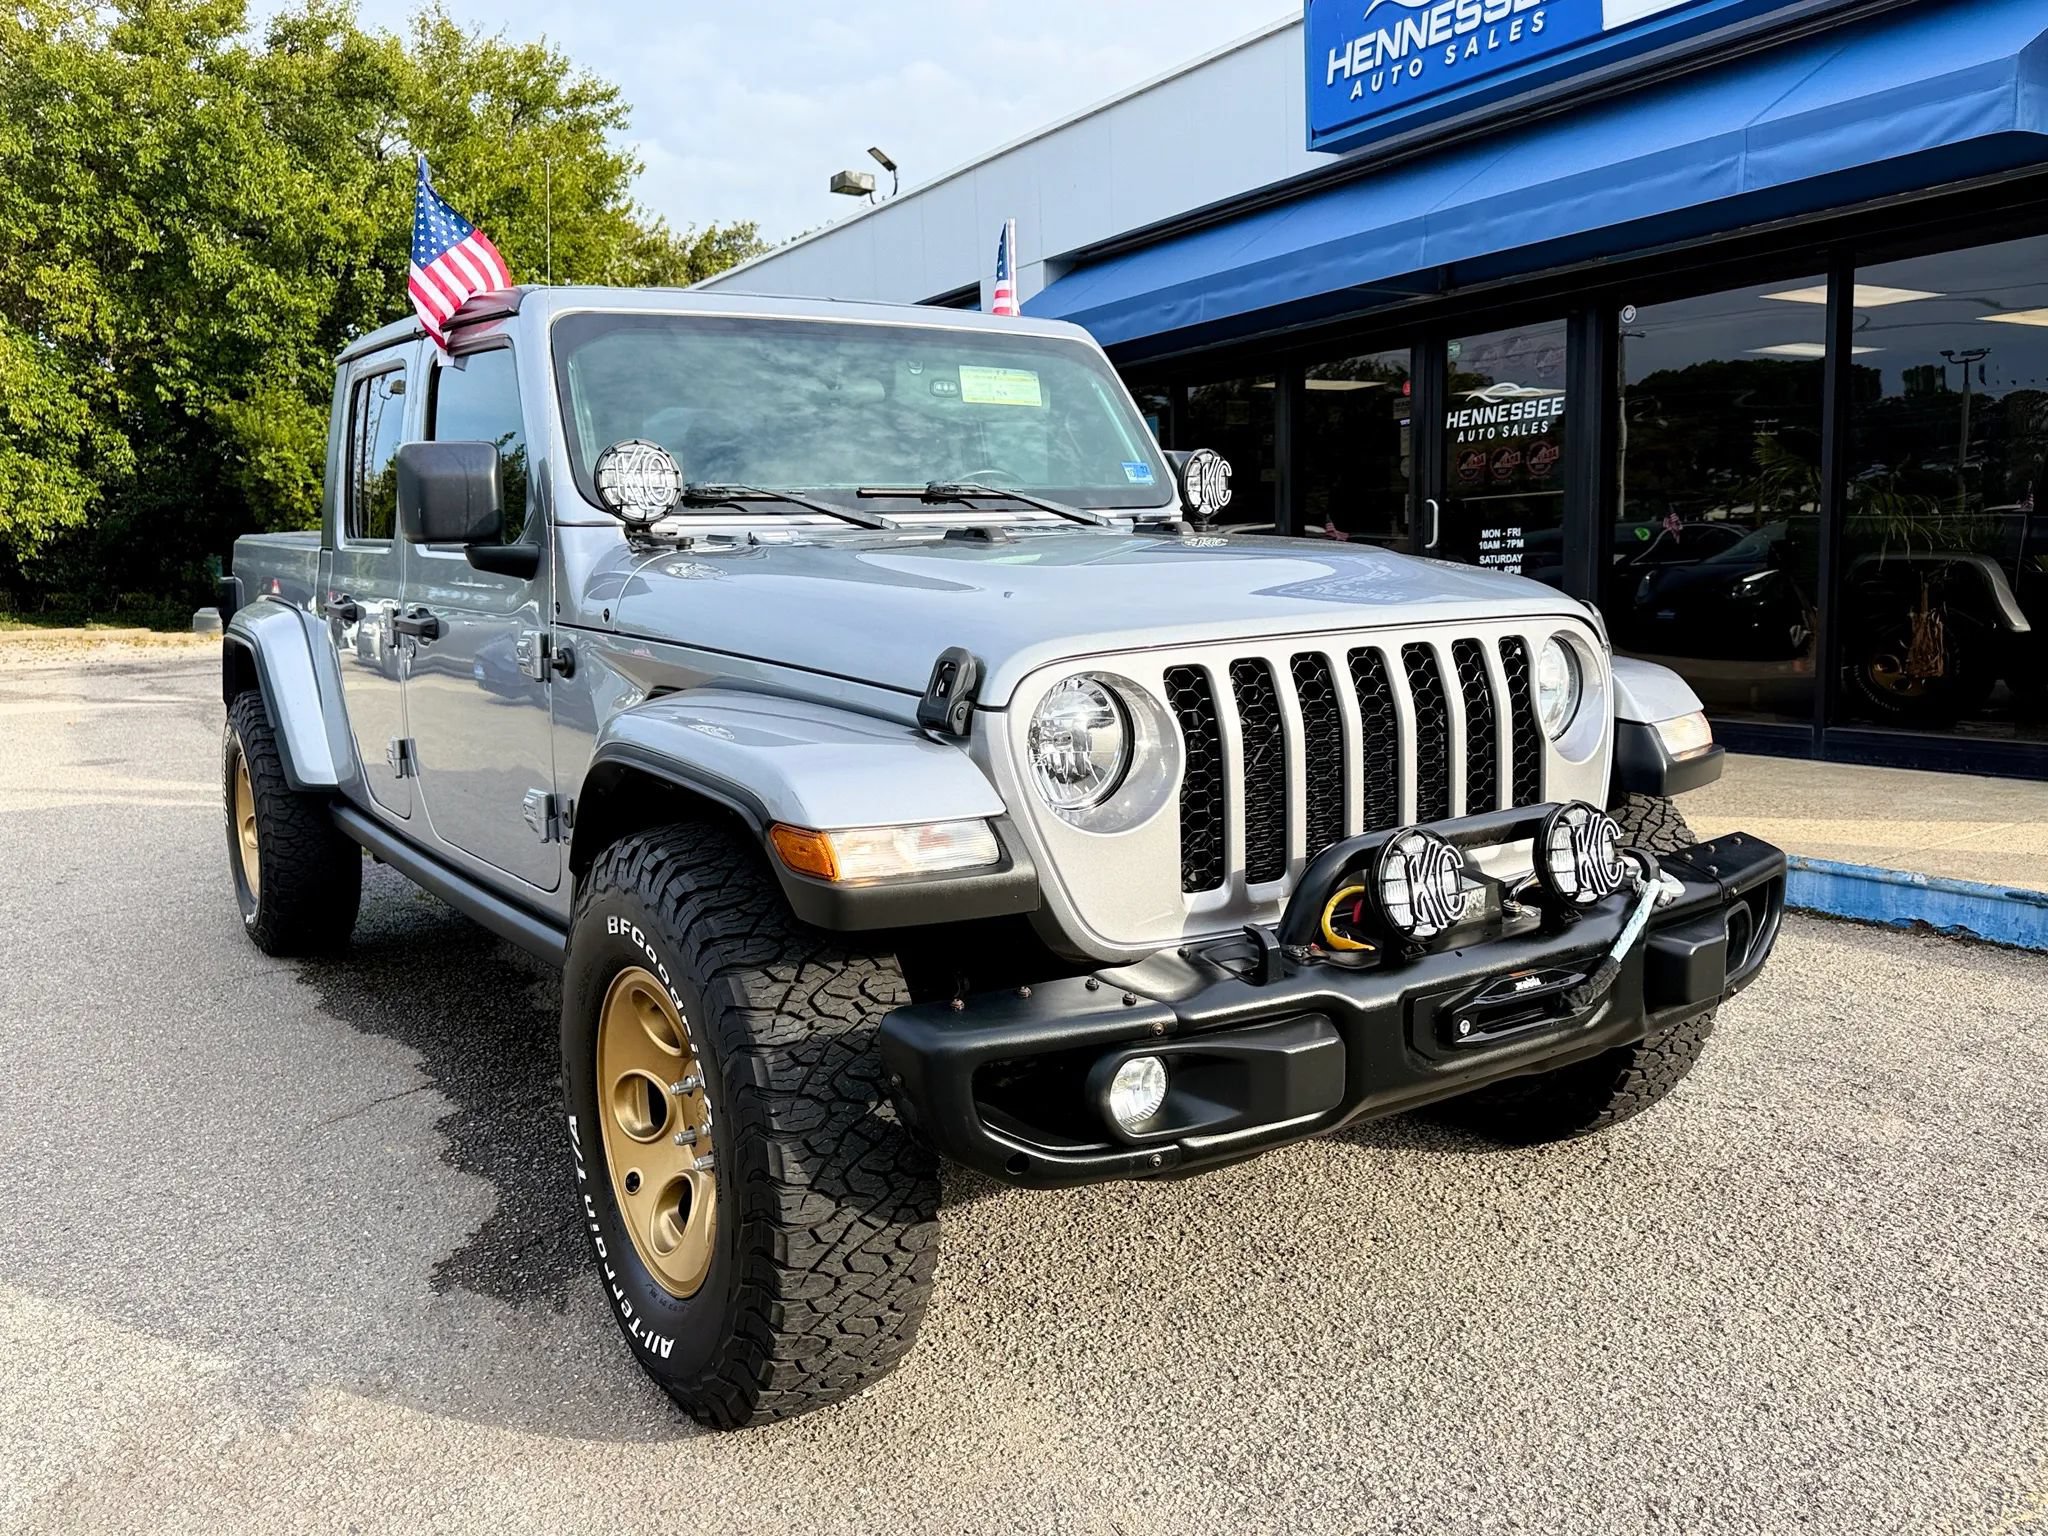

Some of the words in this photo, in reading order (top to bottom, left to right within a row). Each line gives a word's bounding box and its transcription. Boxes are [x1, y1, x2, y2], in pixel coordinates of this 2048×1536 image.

[1327, 0, 1546, 86] HENNESS
[1350, 58, 1423, 101] AUTO
[1444, 11, 1545, 65] SALES
[1446, 396, 1566, 429] HENNESSEE
[1457, 427, 1496, 443] AUTO
[1502, 420, 1549, 438] SALES
[614, 445, 674, 511] KC
[1202, 456, 1232, 509] KC
[1479, 540, 1500, 550] 10AM
[1506, 538, 1524, 549] 7PM
[1479, 553, 1523, 564] SATURDAY
[1481, 528, 1501, 539] MON
[1507, 527, 1521, 537] FRI
[1576, 813, 1624, 895] KC
[1409, 840, 1468, 929] KC
[584, 1194, 675, 1359] All-Terrain
